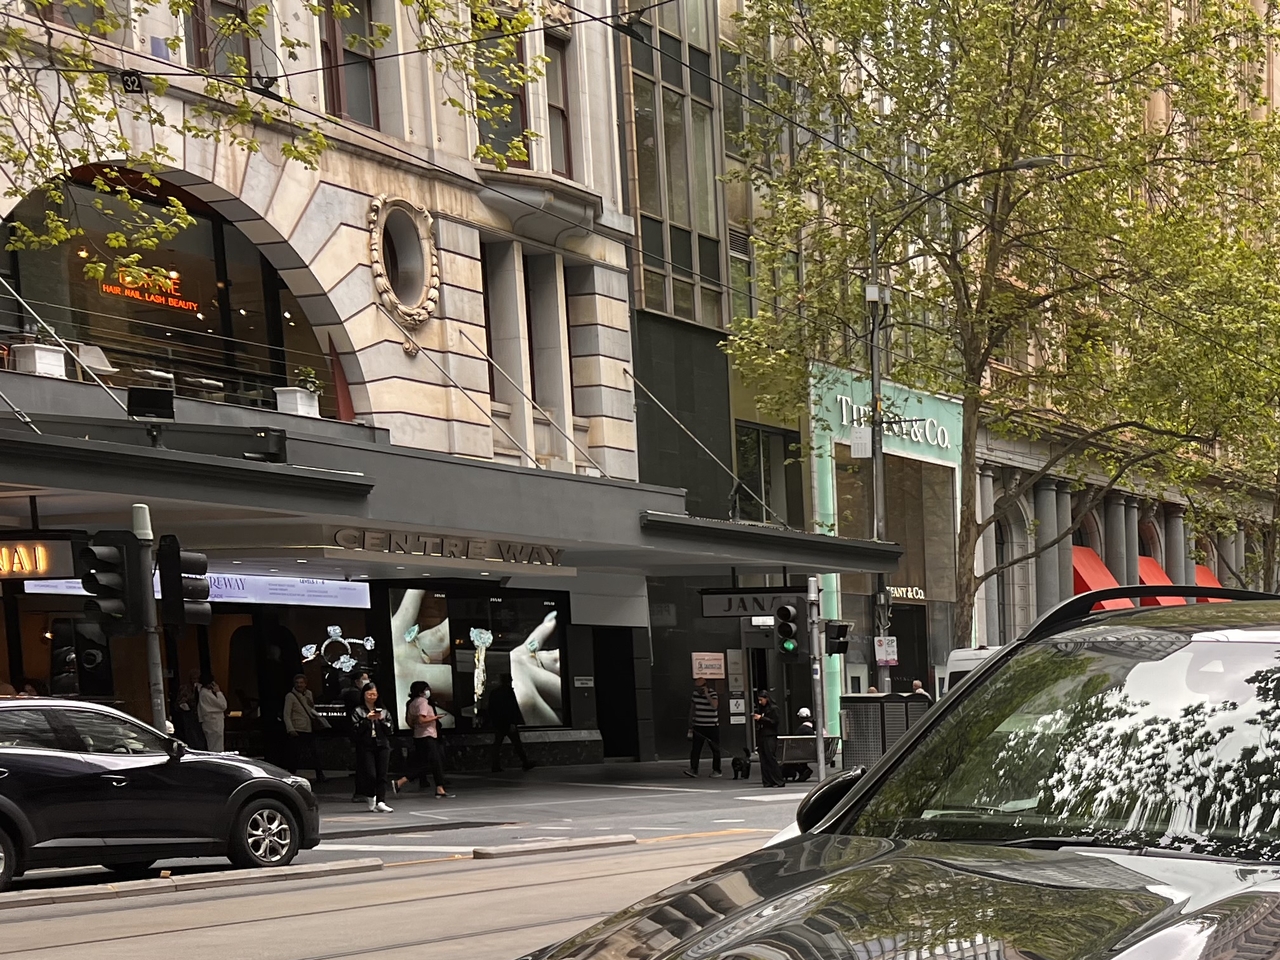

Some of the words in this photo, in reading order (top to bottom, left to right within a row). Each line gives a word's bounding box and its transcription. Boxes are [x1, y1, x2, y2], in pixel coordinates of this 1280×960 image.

[123, 76, 141, 91] 32
[102, 284, 121, 296] HAIR
[124, 289, 142, 300] NAIL
[145, 293, 165, 305] LASH
[168, 298, 198, 311] BEAUTY
[334, 528, 488, 559] CENTRE
[498, 542, 566, 566] WAY
